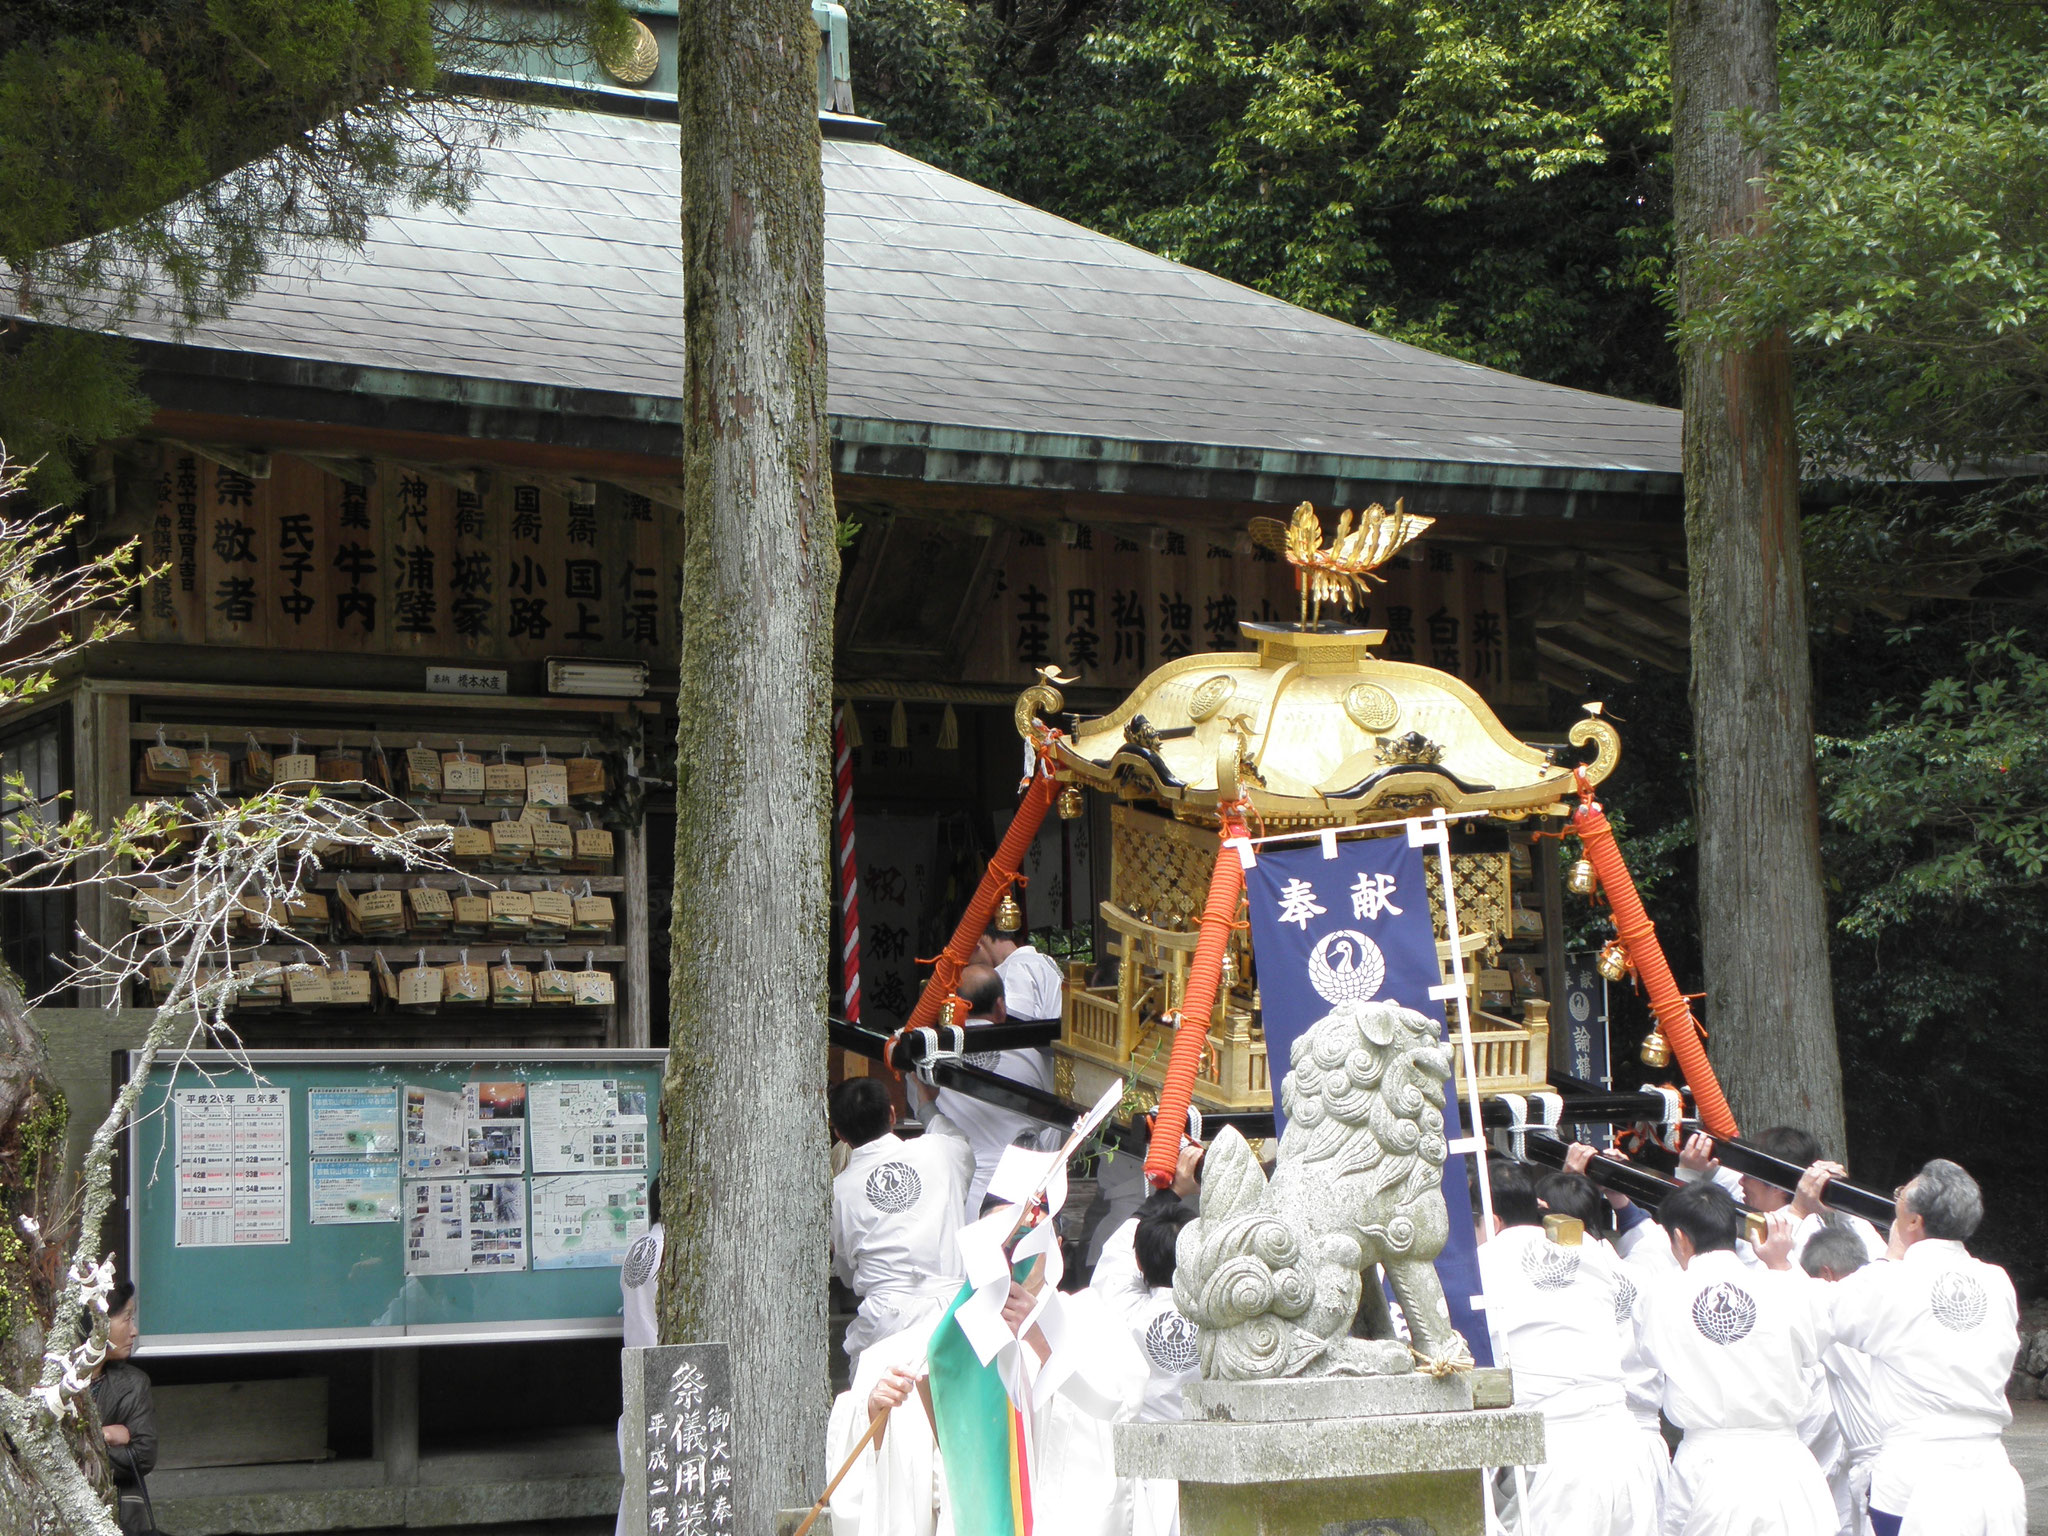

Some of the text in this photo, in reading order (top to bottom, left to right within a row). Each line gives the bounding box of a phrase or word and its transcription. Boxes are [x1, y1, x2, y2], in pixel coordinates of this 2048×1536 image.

[213, 463, 257, 623] 崇敬者
[279, 514, 315, 624] 氏子中
[393, 474, 437, 634] 神代 浦壁
[508, 485, 552, 640] 国衙 小路
[333, 542, 377, 632] 牛内
[449, 551, 493, 637] 城家
[564, 558, 604, 642] 国上
[619, 560, 659, 646] 仁頃
[1016, 584, 1052, 663] 土生
[1065, 588, 1100, 668] 円実
[1111, 589, 1146, 670] 払川
[1472, 608, 1503, 683] 来川
[1277, 872, 1404, 931] 奉献
[246, 1094, 279, 1105] 厄年表
[647, 1413, 670, 1532] 平成二年
[707, 1406, 733, 1536] 御大典奉
